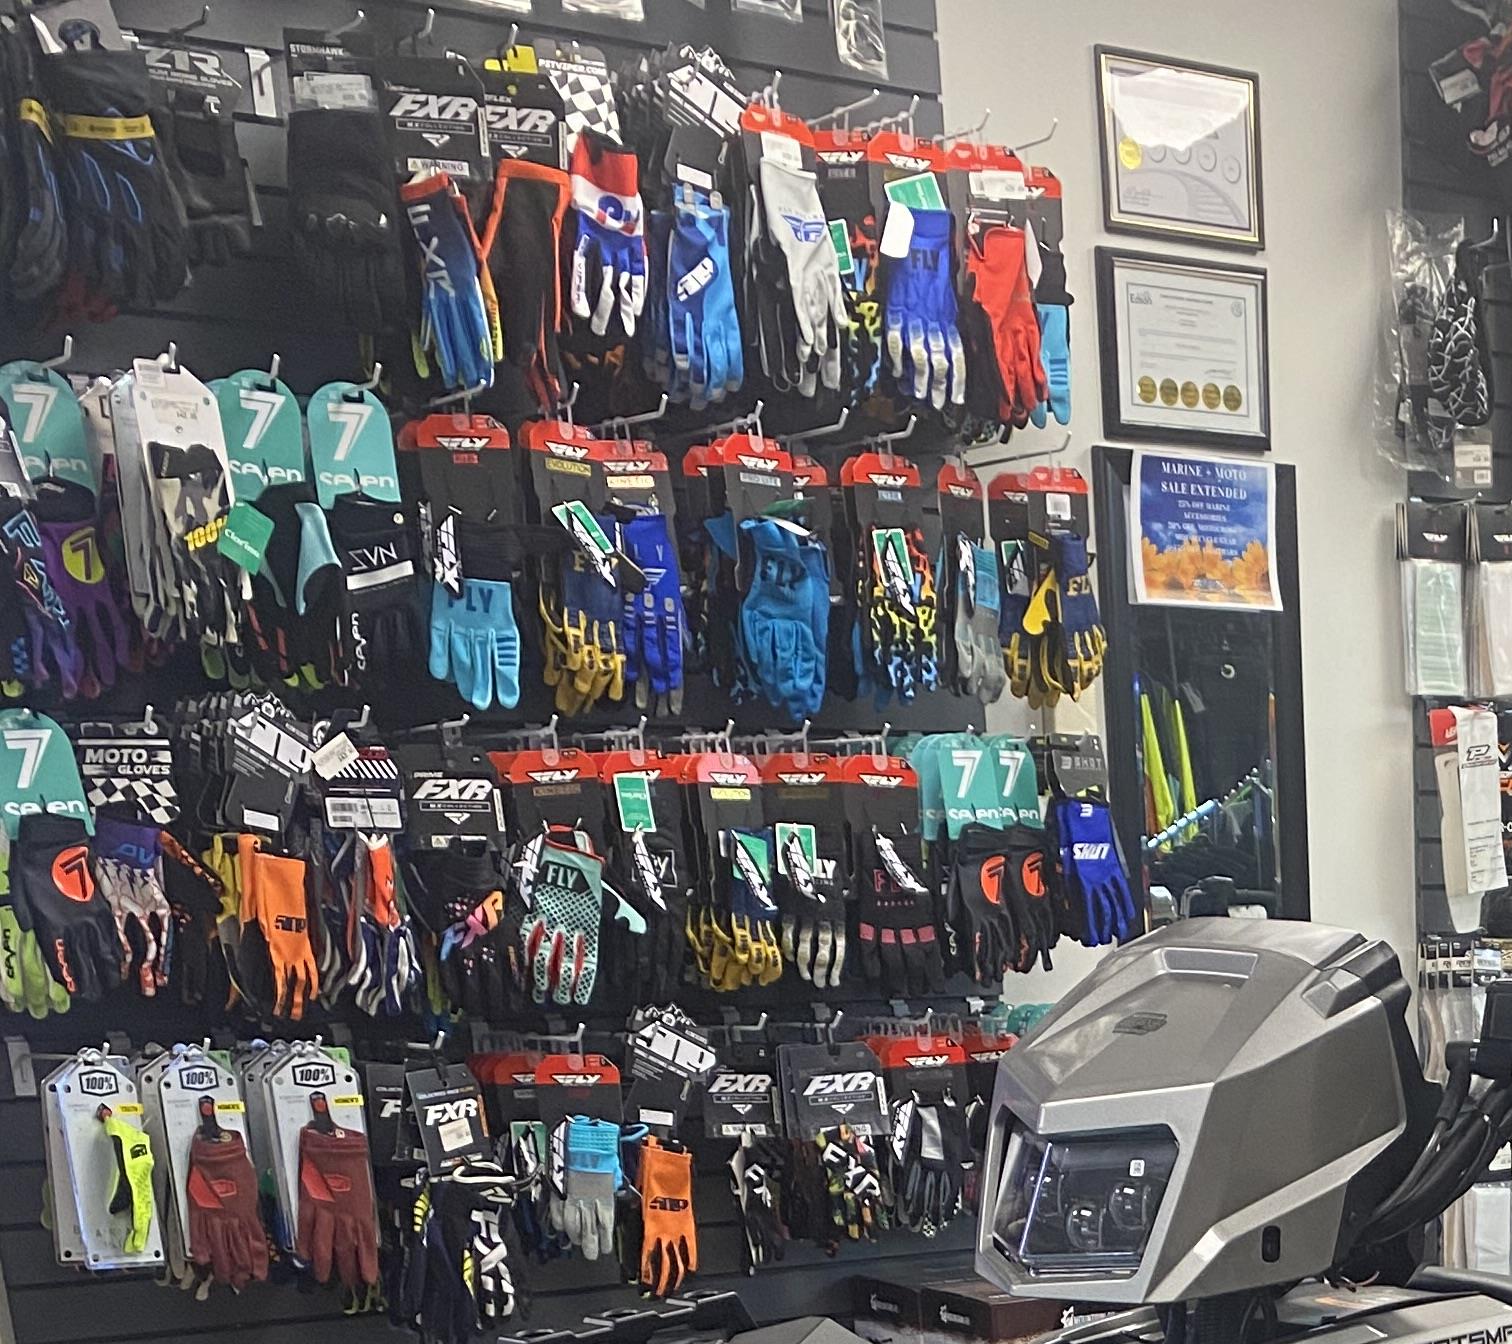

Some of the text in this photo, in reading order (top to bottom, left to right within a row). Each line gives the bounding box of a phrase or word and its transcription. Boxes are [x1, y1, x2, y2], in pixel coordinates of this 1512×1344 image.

[389, 94, 477, 120] FXR
[884, 152, 933, 171] FLY
[407, 204, 455, 298] FXR
[10, 383, 59, 443] 7
[239, 389, 285, 449] 7
[326, 402, 374, 461] 7
[435, 436, 491, 451] FLY
[544, 440, 590, 460] FLY
[602, 460, 651, 472] FLY
[737, 455, 781, 471] FLY
[1161, 462, 1202, 476] MARINE
[1161, 481, 1247, 500] SALE EXTENDED
[3, 729, 52, 789] 7
[85, 749, 148, 763] MOTO
[118, 765, 170, 775] GLOVES
[527, 769, 579, 782] FLY
[709, 772, 748, 785] FLY
[777, 772, 826, 785] FLY
[951, 750, 983, 798] 7
[999, 751, 1025, 797] 7
[412, 779, 493, 800] FXR
[858, 774, 904, 787] FLY
[546, 864, 579, 888] FLY
[904, 1055, 949, 1068] FLY
[85, 1076, 113, 1091] 100%
[186, 1071, 214, 1085] 100%
[299, 1068, 329, 1082] 100%
[551, 1074, 602, 1086] FLY
[708, 1074, 772, 1093] FXR
[803, 1072, 875, 1096] FXR
[423, 1099, 479, 1126] FXR
